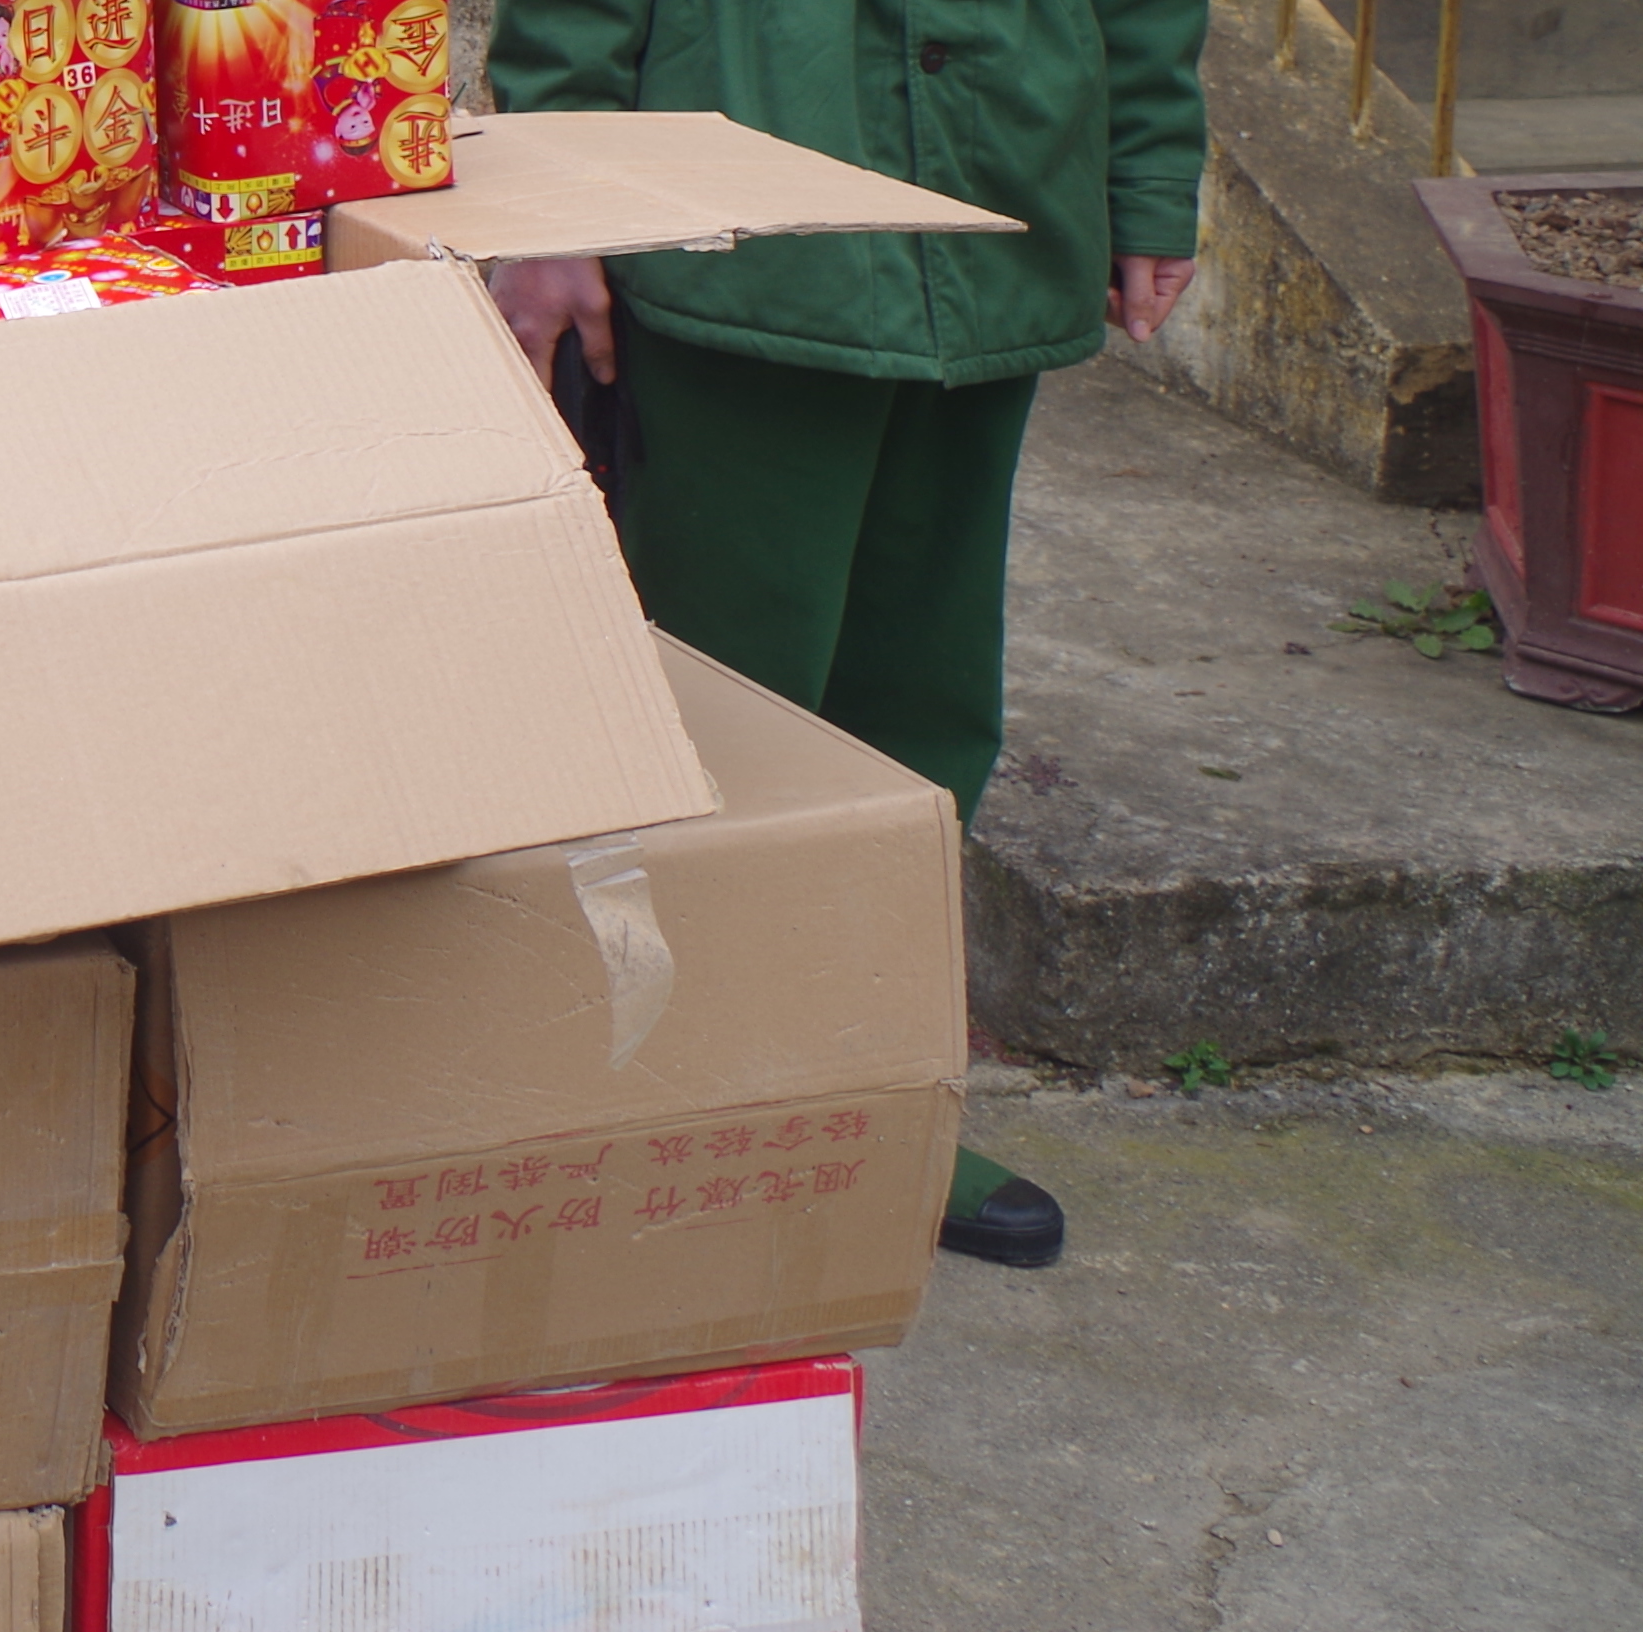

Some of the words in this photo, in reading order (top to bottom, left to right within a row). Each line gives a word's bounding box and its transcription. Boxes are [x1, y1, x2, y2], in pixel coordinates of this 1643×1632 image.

[66, 65, 94, 87] 36
[647, 1109, 872, 1165] 轻拿轻放
[373, 1142, 613, 1211] 严禁倒置
[634, 1158, 866, 1221] 烟花爆竹
[362, 1195, 602, 1260] 防火防潮
